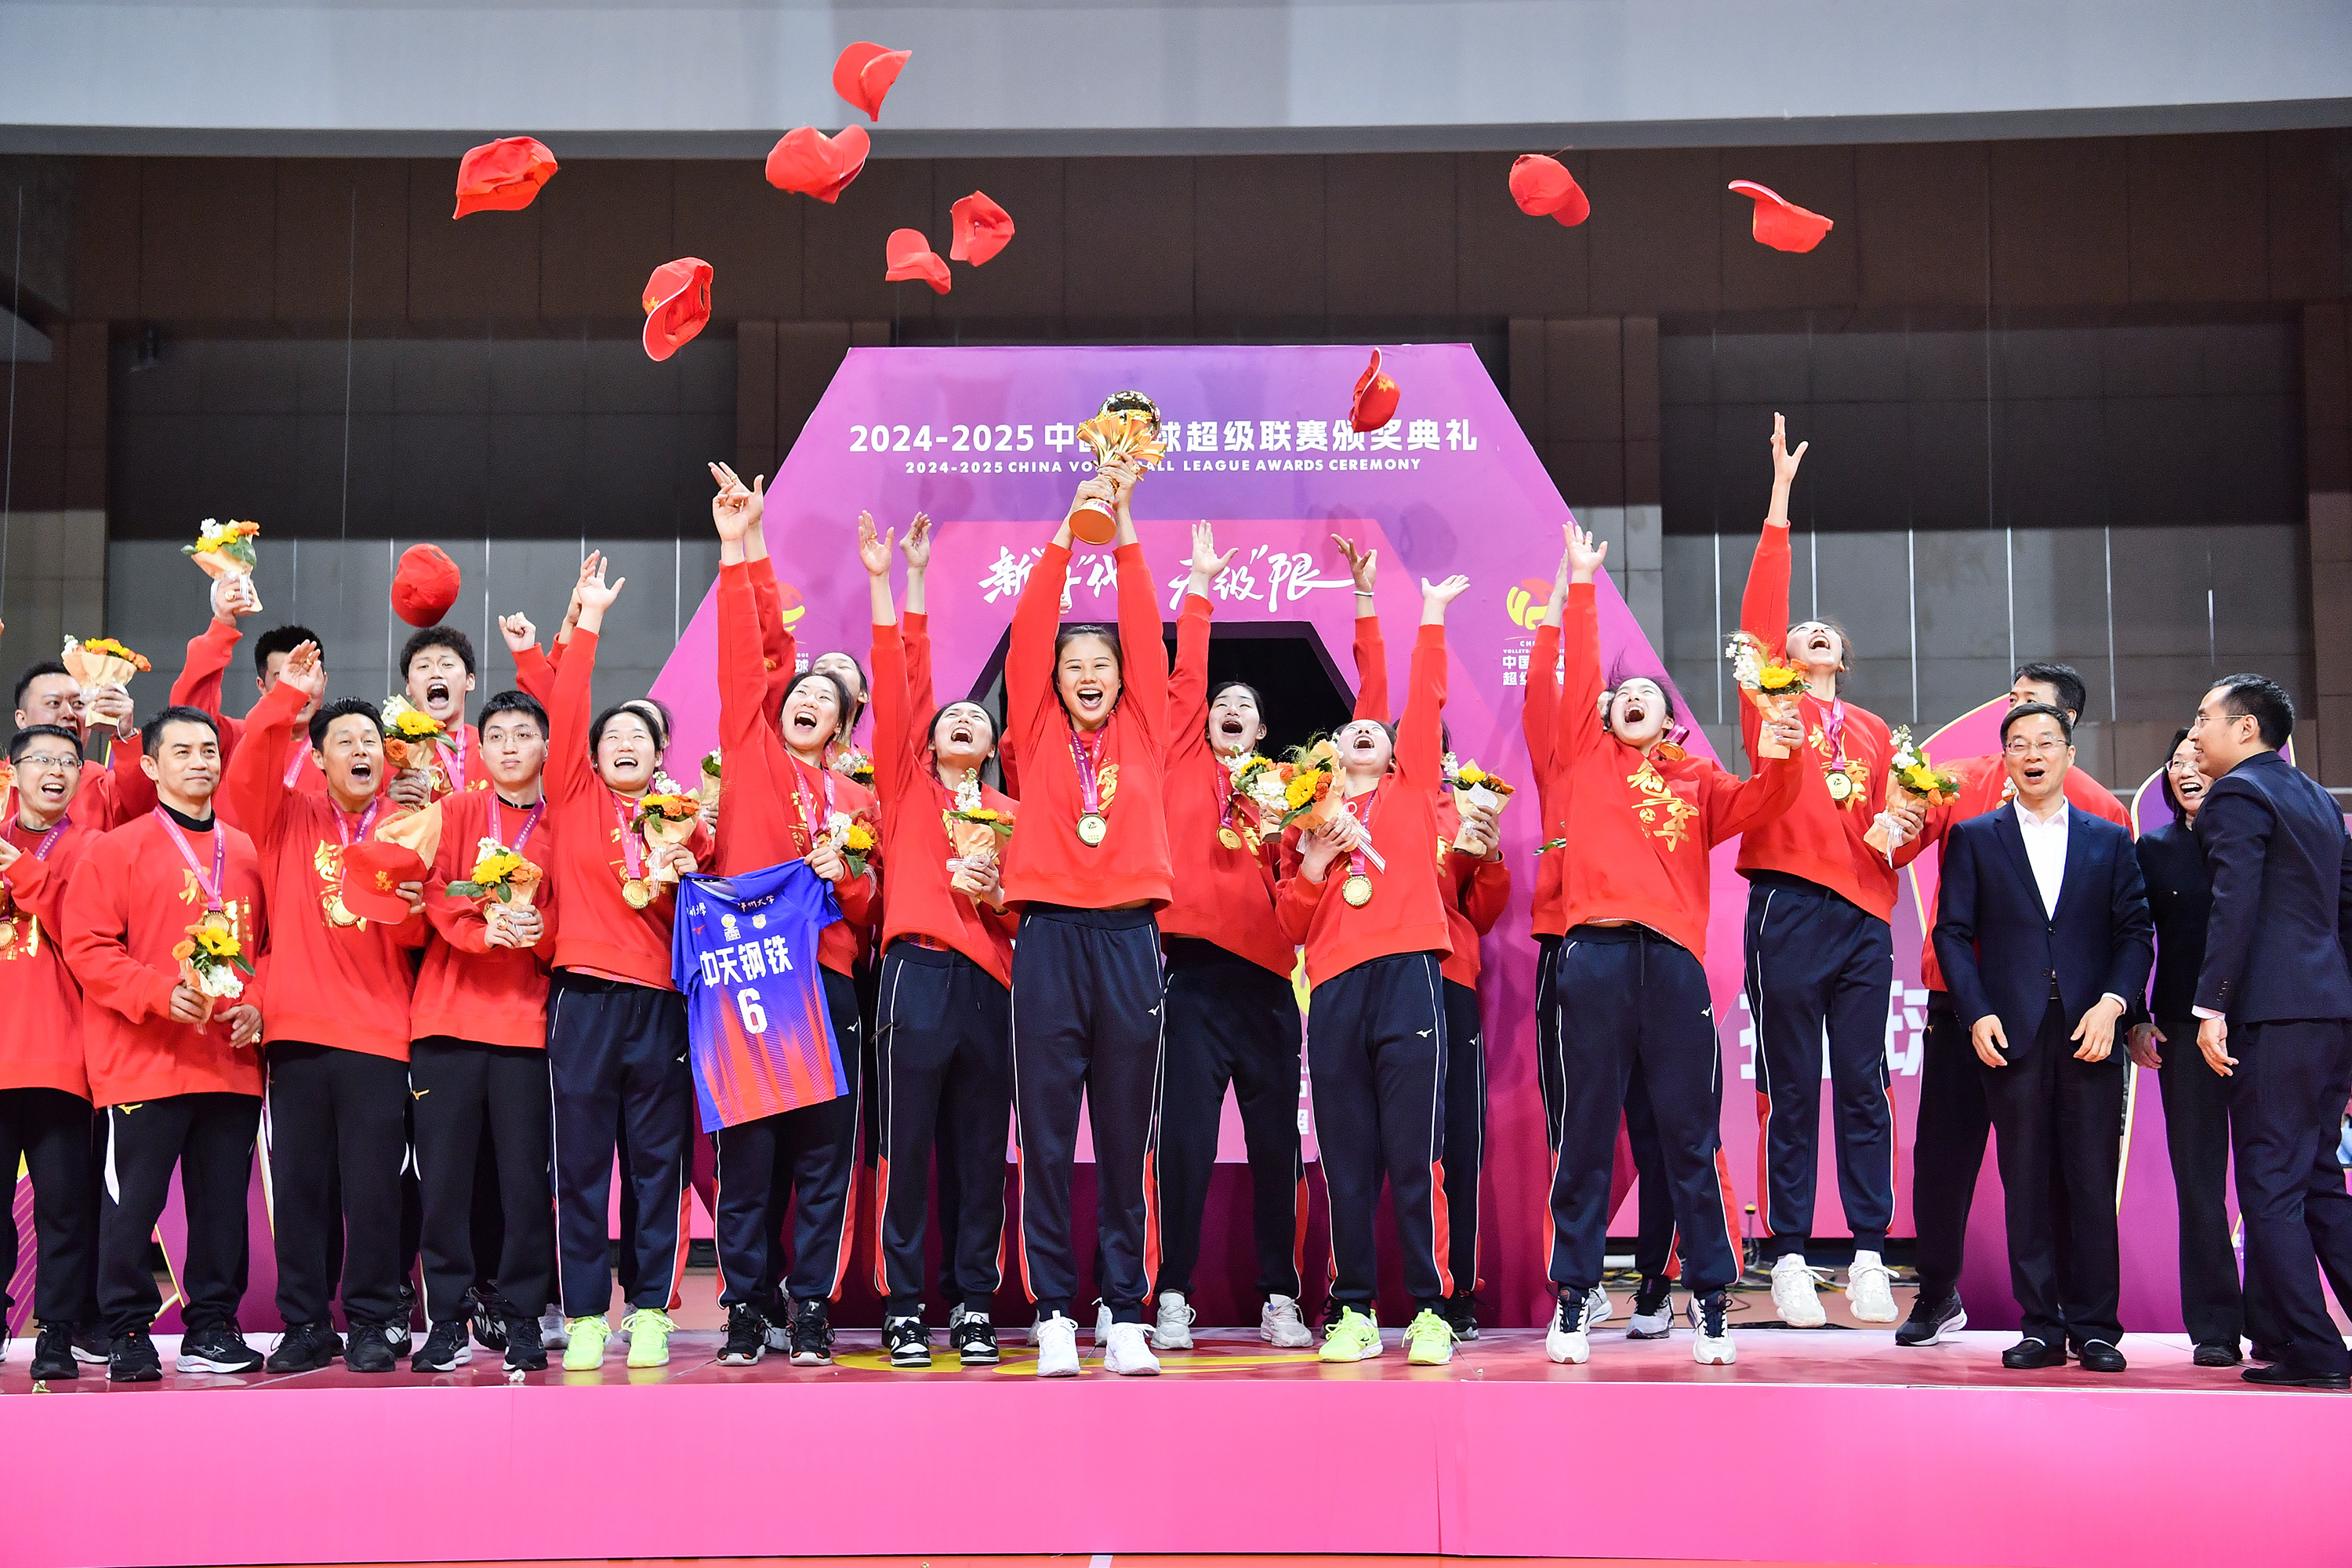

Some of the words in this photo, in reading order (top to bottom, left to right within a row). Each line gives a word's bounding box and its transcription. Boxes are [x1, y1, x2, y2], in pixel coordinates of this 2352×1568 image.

[849, 424, 1034, 452] 2024-2025
[1044, 419, 1477, 452] 中球超级联赛颁奖典礼
[906, 462, 1004, 474] 2024-2025
[1008, 461, 1062, 473] CHINA
[1069, 460, 1175, 472] VOALL
[1183, 459, 1250, 471] LEAGUE
[1255, 459, 1323, 471] AWARDS
[1328, 458, 1421, 470] CEREMONY
[699, 935, 793, 989] 中天钢铁
[737, 987, 768, 1034] 6
